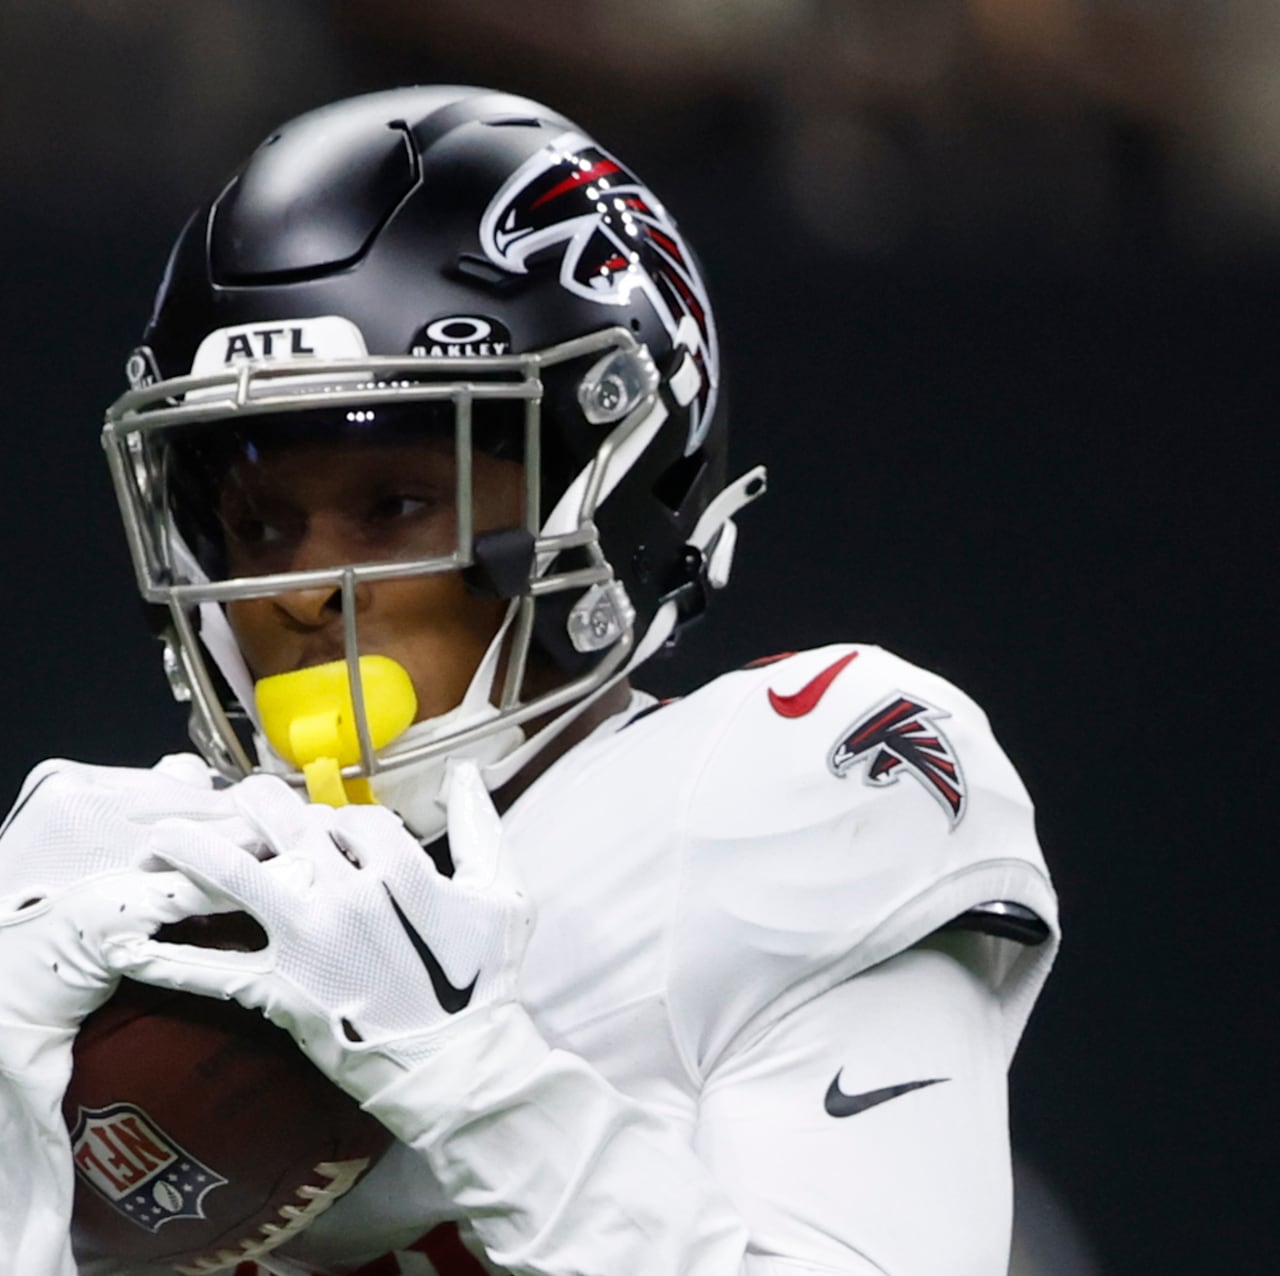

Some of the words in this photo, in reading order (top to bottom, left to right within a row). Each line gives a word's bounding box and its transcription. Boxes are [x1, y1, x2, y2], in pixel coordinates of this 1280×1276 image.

[225, 328, 314, 362] ATL
[411, 342, 508, 358] OAKLEY
[75, 1116, 172, 1193] NFL
